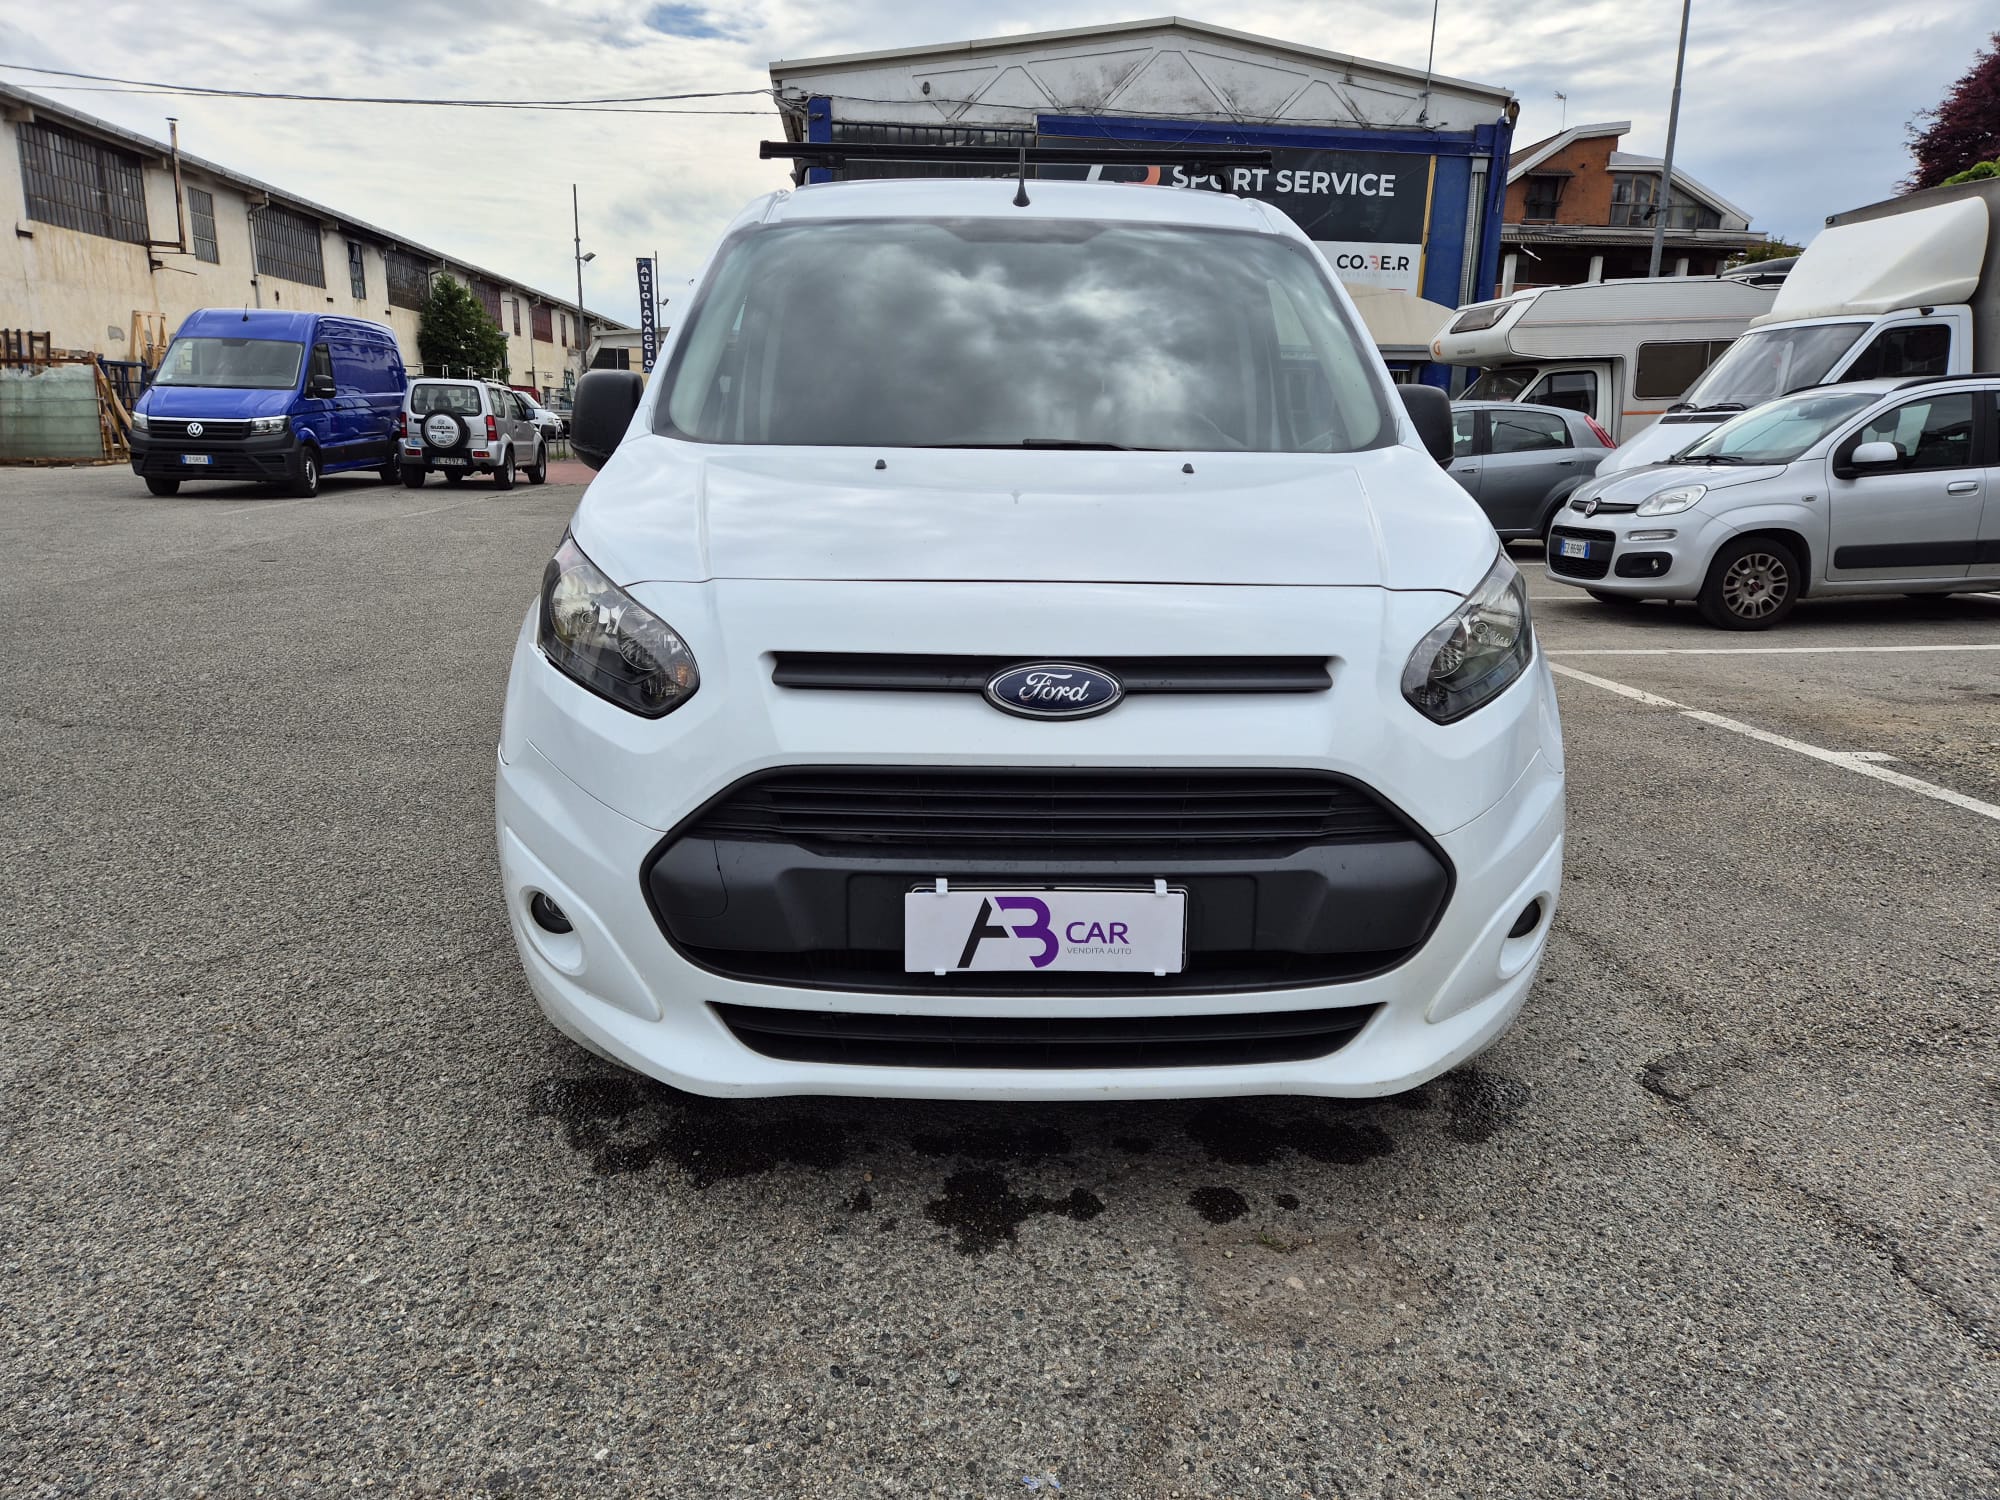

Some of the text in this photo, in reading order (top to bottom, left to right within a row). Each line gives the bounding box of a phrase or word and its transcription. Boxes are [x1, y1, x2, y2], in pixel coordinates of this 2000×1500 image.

[1275, 170, 1396, 197] SERVICE
[640, 266, 654, 367] AUTOLAVAGGIO
[1018, 672, 1090, 702] Ford
[1065, 921, 1130, 945] CAR
[1066, 946, 1132, 955] VENDITA AUTO
